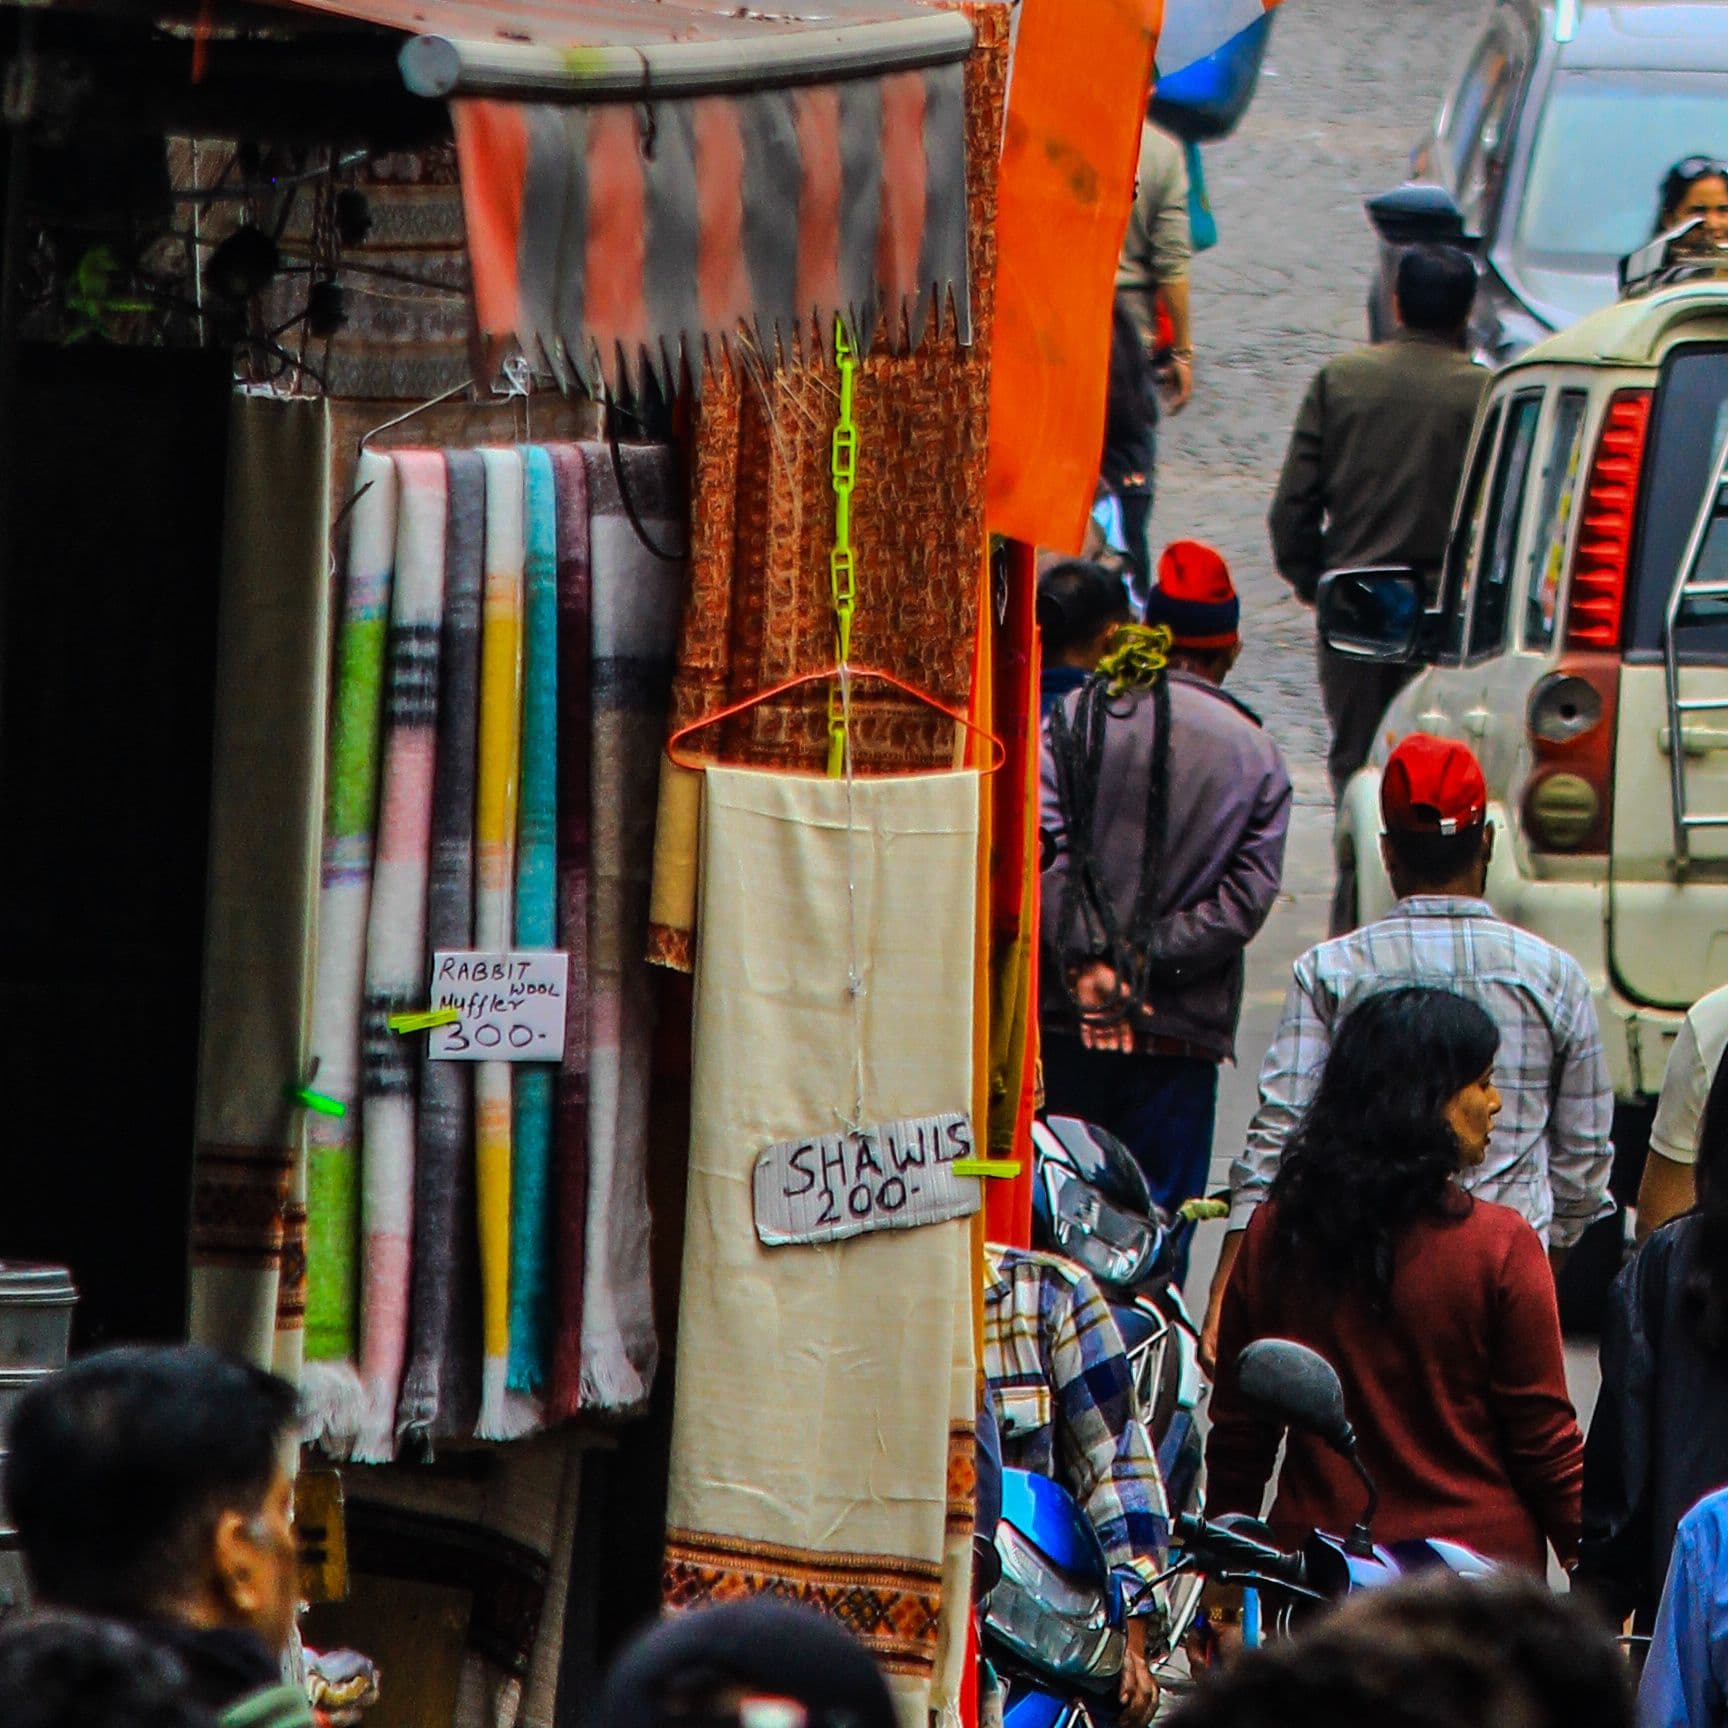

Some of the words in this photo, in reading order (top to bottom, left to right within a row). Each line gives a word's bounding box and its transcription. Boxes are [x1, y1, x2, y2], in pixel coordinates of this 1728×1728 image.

[439, 957, 531, 982] RABBIT
[510, 983, 560, 997] WOOL
[783, 1121, 971, 1196] SHAWLS
